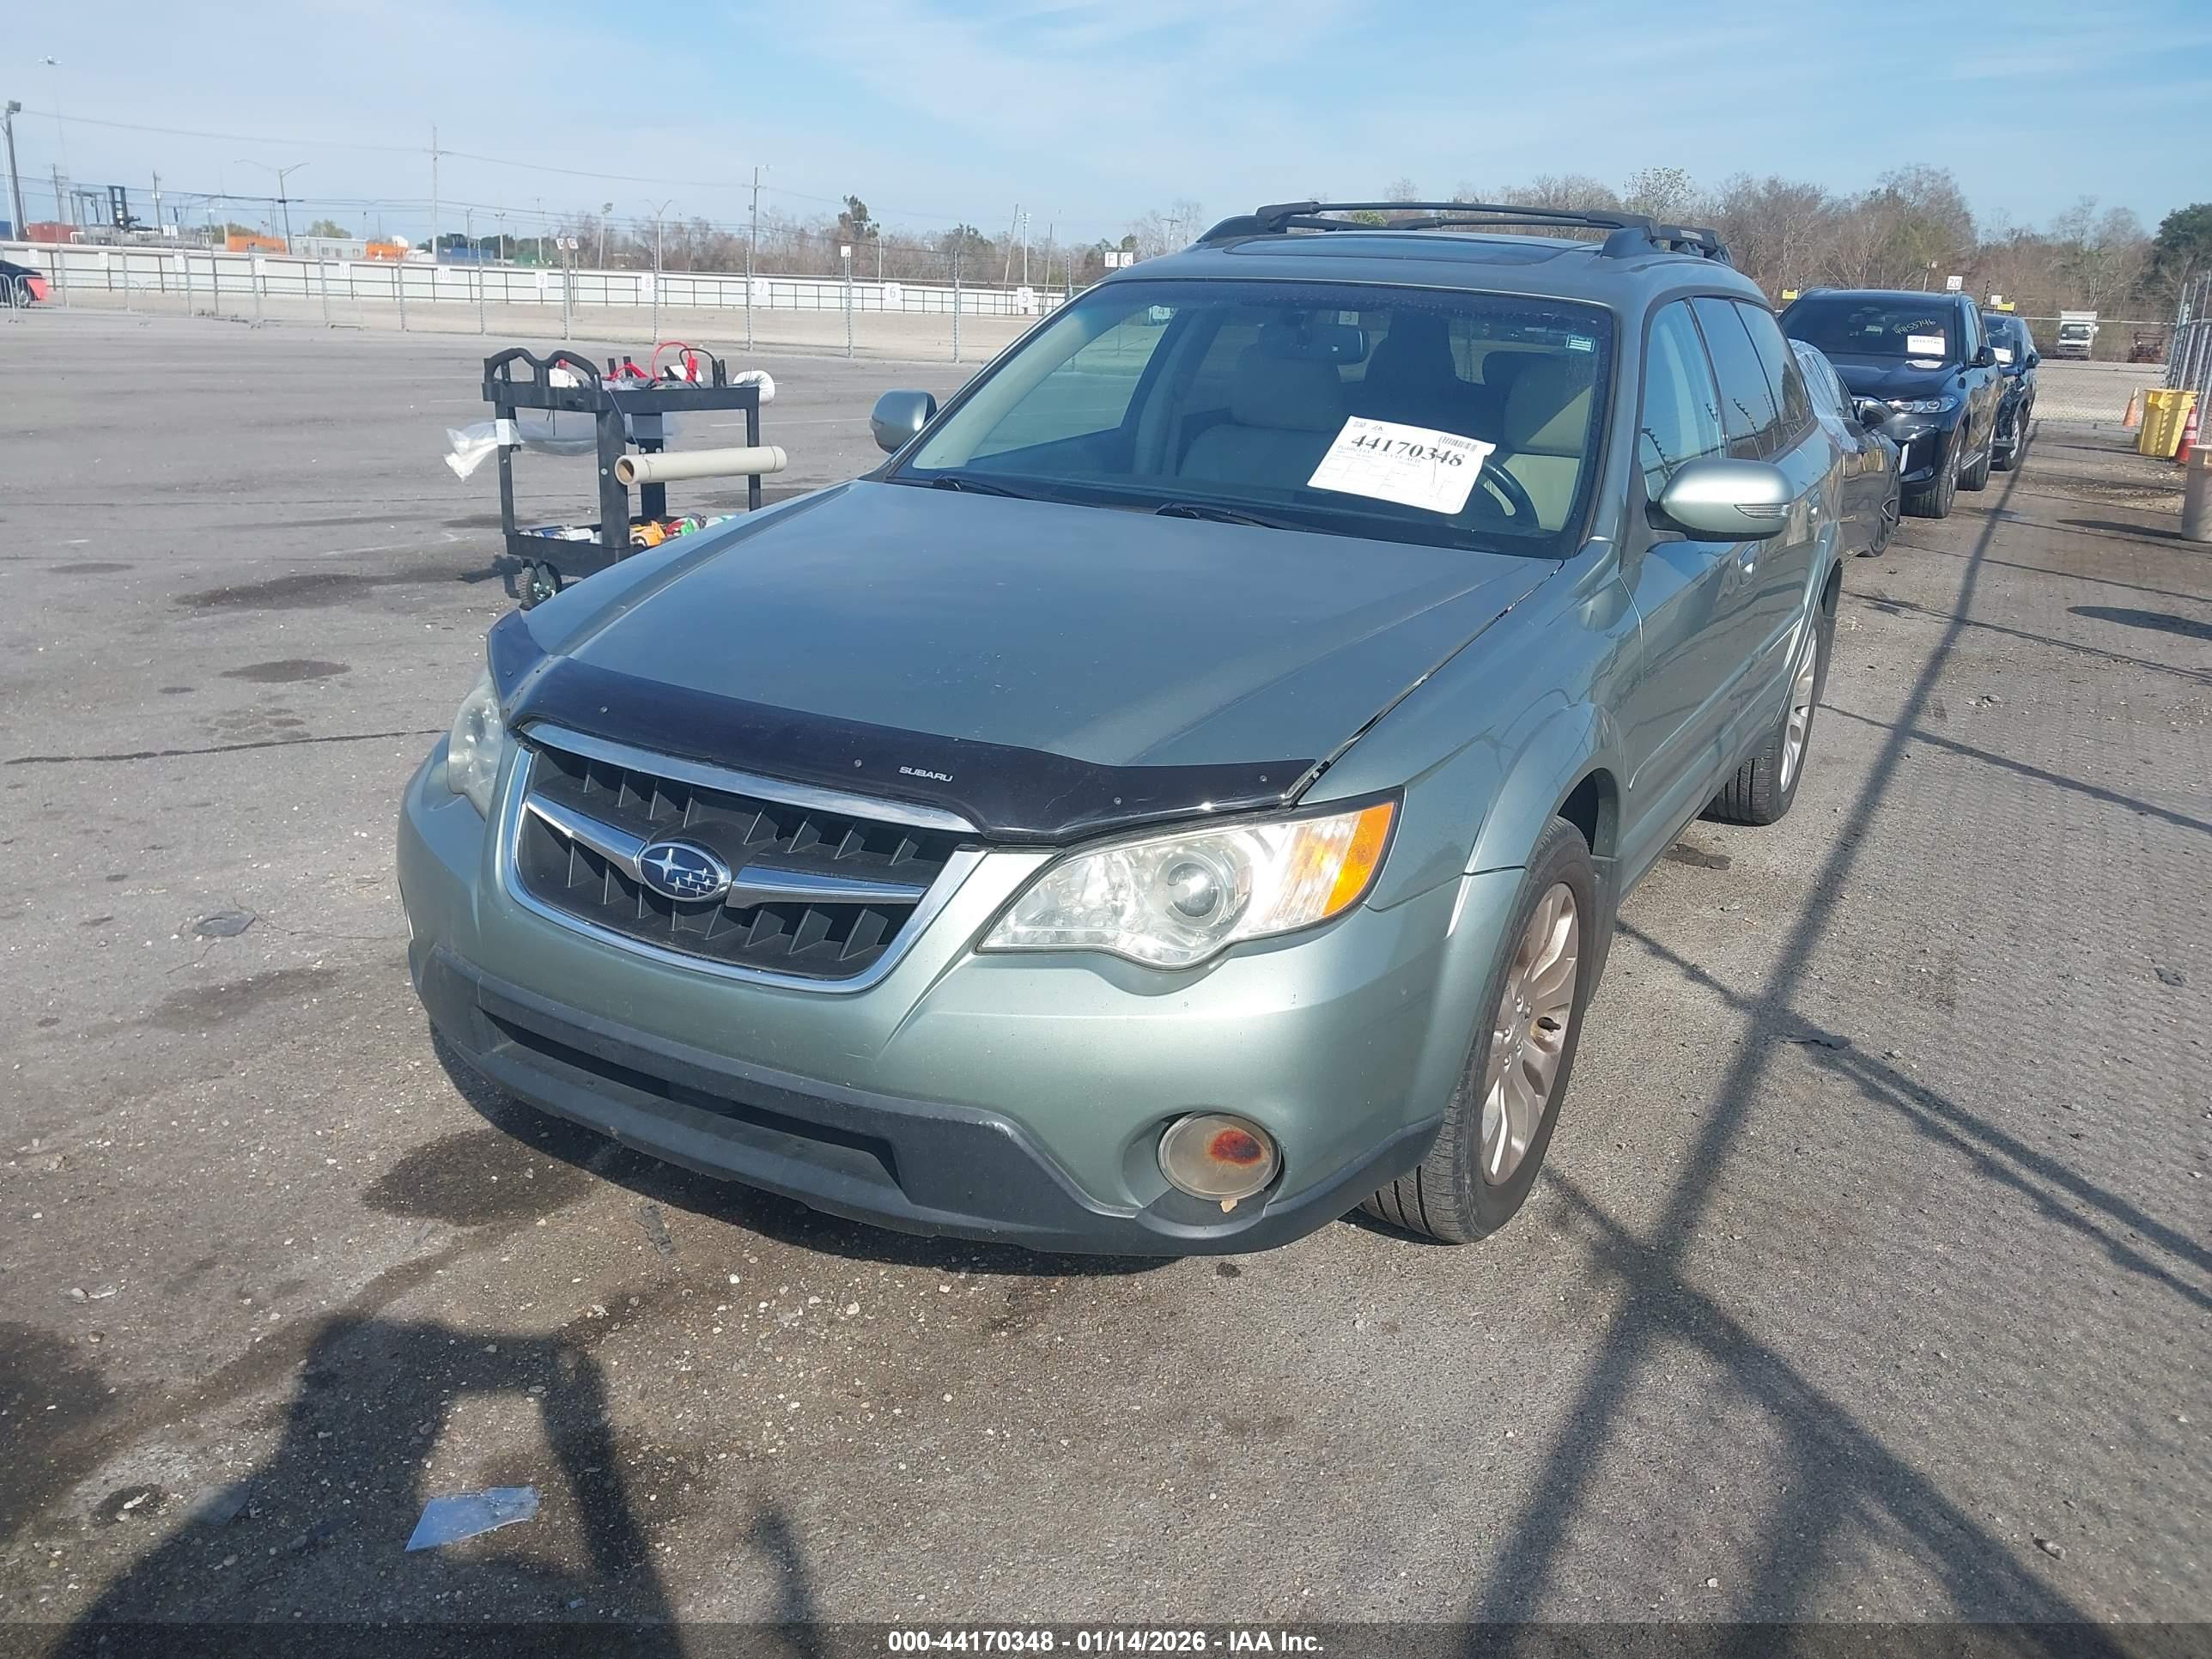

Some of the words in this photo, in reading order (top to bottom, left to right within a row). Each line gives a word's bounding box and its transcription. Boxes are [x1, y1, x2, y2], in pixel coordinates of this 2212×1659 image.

[1122, 253, 1132, 266] G
[439, 269, 449, 281] 10
[538, 274, 544, 285] 9
[645, 276, 651, 289] 8
[758, 281, 765, 293] 7
[1948, 277, 1961, 289] 20
[890, 286, 896, 299] 6
[1023, 290, 1030, 303] 5
[1352, 434, 1465, 466] 44170348
[898, 766, 953, 782] SUBARU
